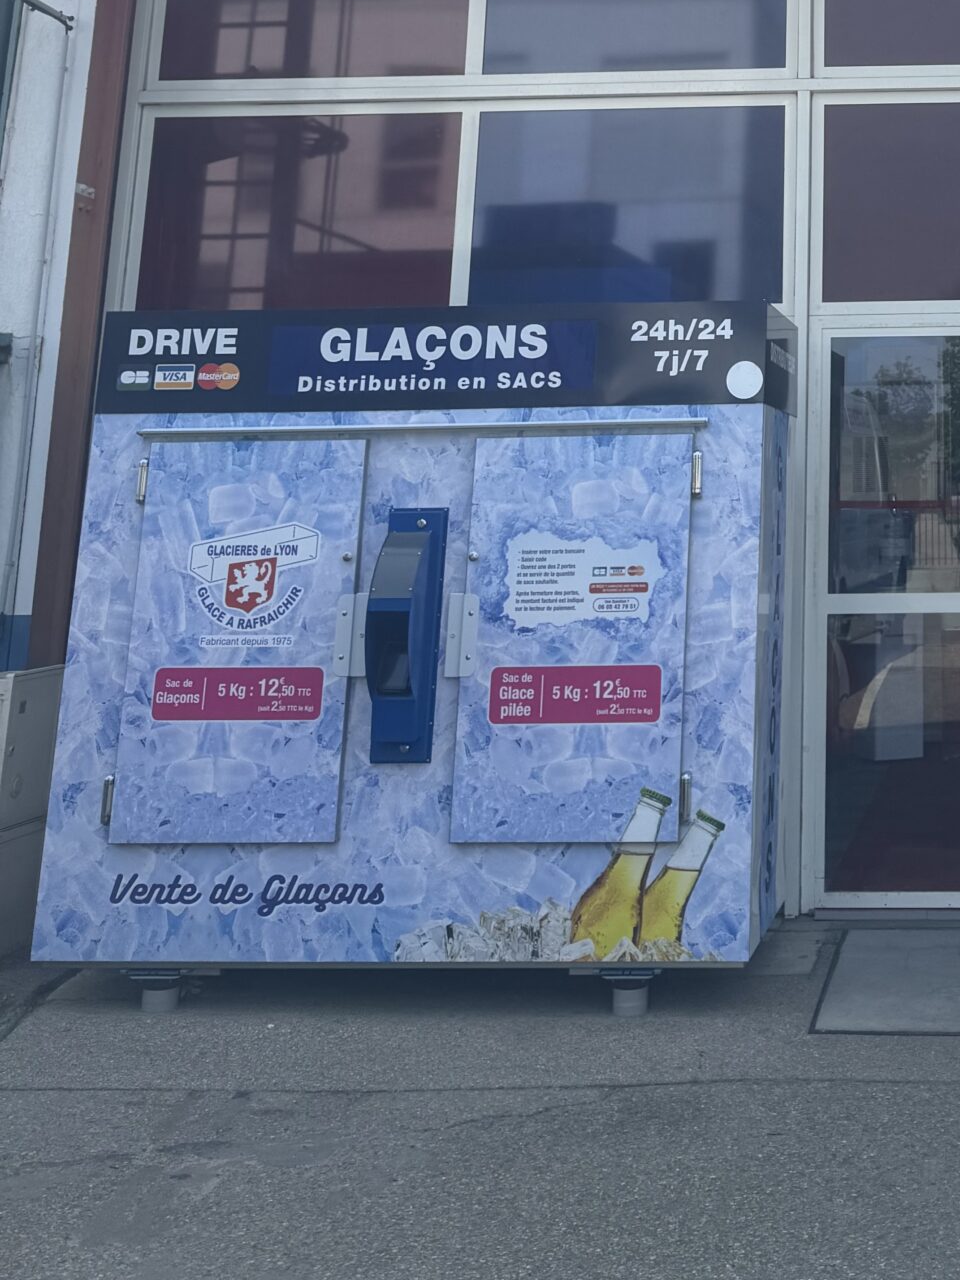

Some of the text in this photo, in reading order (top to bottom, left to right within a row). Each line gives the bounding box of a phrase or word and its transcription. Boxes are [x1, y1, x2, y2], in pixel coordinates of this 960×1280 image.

[630, 318, 734, 342] 24h/24
[128, 327, 239, 356] DRIVE
[320, 323, 548, 370] GLAÇONS
[654, 349, 709, 376] 7j/7
[162, 372, 187, 381] VISA
[197, 371, 240, 382] MasterCard
[298, 371, 562, 392] Distribution en SACS
[207, 544, 298, 557] GLACIERES de LYON
[198, 586, 302, 630] GLACE A RAFRAICHIR
[200, 637, 292, 648] Fabricant depuis 1975
[165, 678, 193, 688] Sac de
[502, 673, 533, 683] Sac de
[155, 691, 200, 707] Glaçons
[218, 683, 226, 697] 5
[229, 683, 246, 700] Kg
[297, 688, 311, 697] TTC
[499, 686, 535, 700] Glace
[552, 686, 560, 699] 5
[564, 686, 581, 702] Kg
[632, 690, 647, 698] TTC
[500, 703, 532, 719] pilée
[109, 873, 385, 917] Vente de Glaçons
